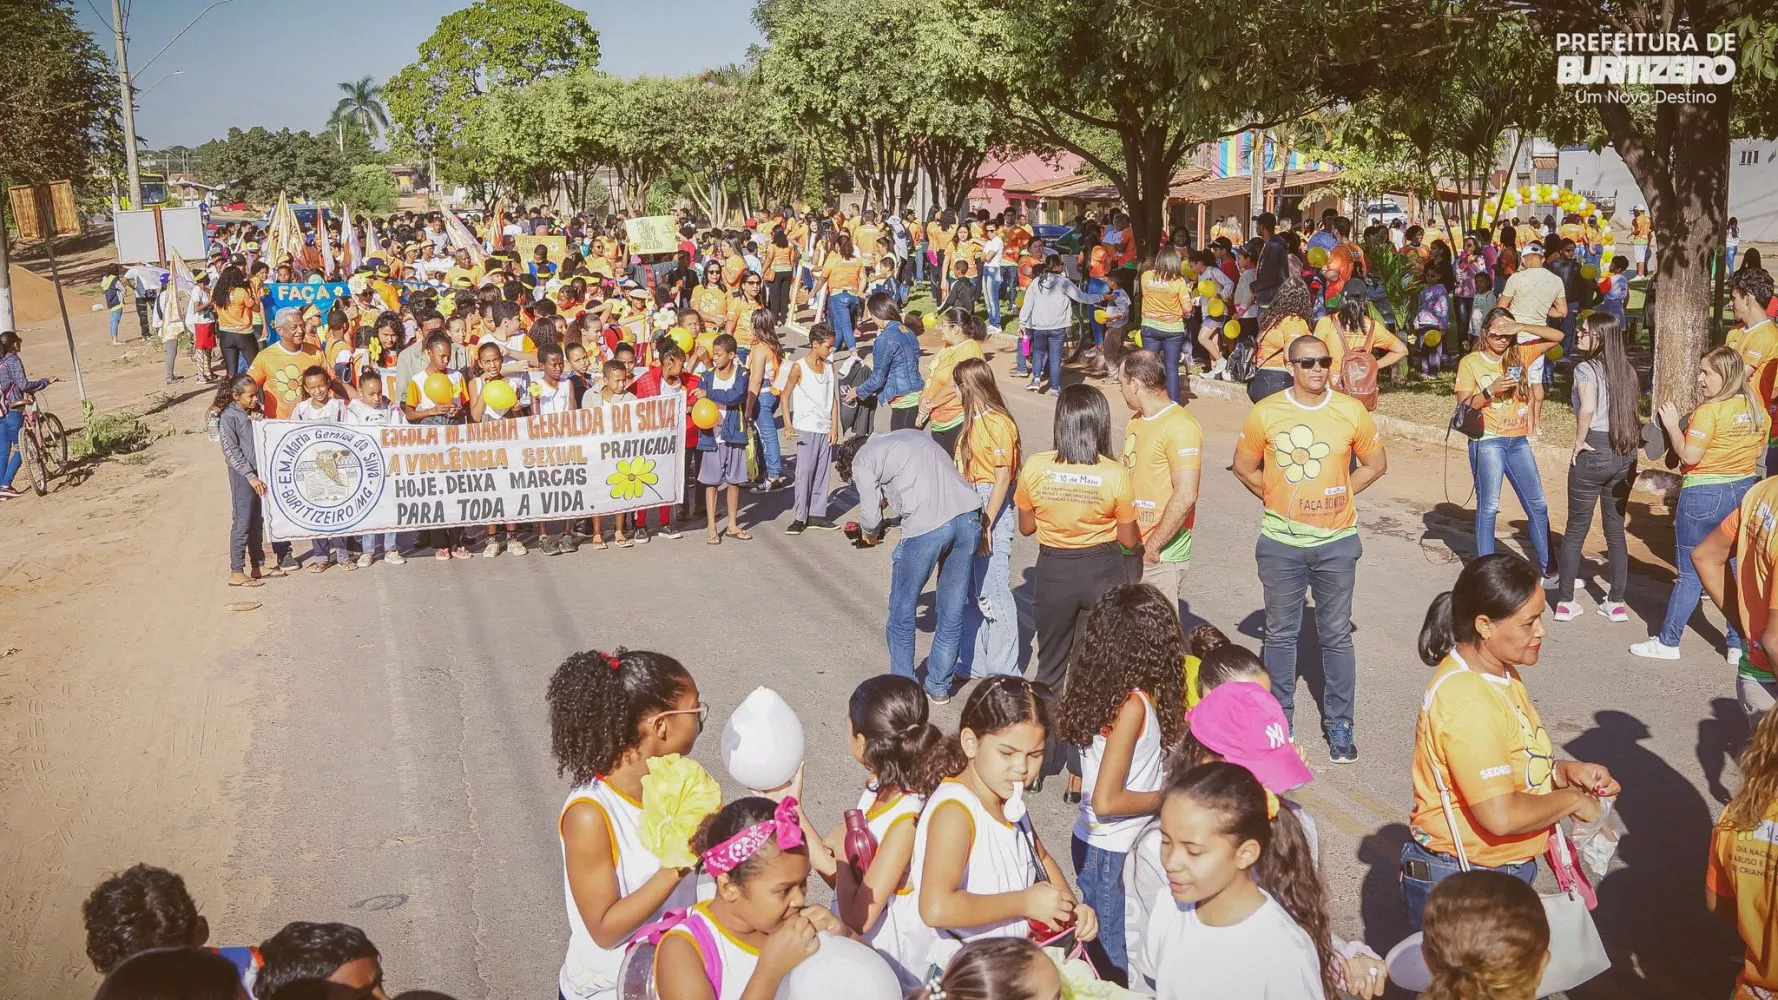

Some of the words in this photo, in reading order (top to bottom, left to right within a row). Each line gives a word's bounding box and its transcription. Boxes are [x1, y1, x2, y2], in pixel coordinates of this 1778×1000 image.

[278, 285, 330, 303] FAÇA
[380, 427, 438, 448] ESCOLA
[466, 417, 518, 443] MARIA
[528, 407, 605, 440] GERALDA
[611, 404, 632, 433] DA
[636, 399, 676, 431] SILVA
[354, 439, 369, 452] da
[386, 454, 401, 476] A
[406, 446, 508, 475] VIOLÊNCIA
[523, 445, 589, 469] SEXUAL
[600, 435, 676, 460] PRATICADA
[446, 473, 496, 494] DEIXA
[510, 468, 587, 489] MARCAS
[397, 500, 445, 525] PARA
[457, 497, 505, 521] TODA
[517, 494, 530, 516] A
[1300, 499, 1322, 511] FAÇA
[1265, 722, 1286, 749] NY
